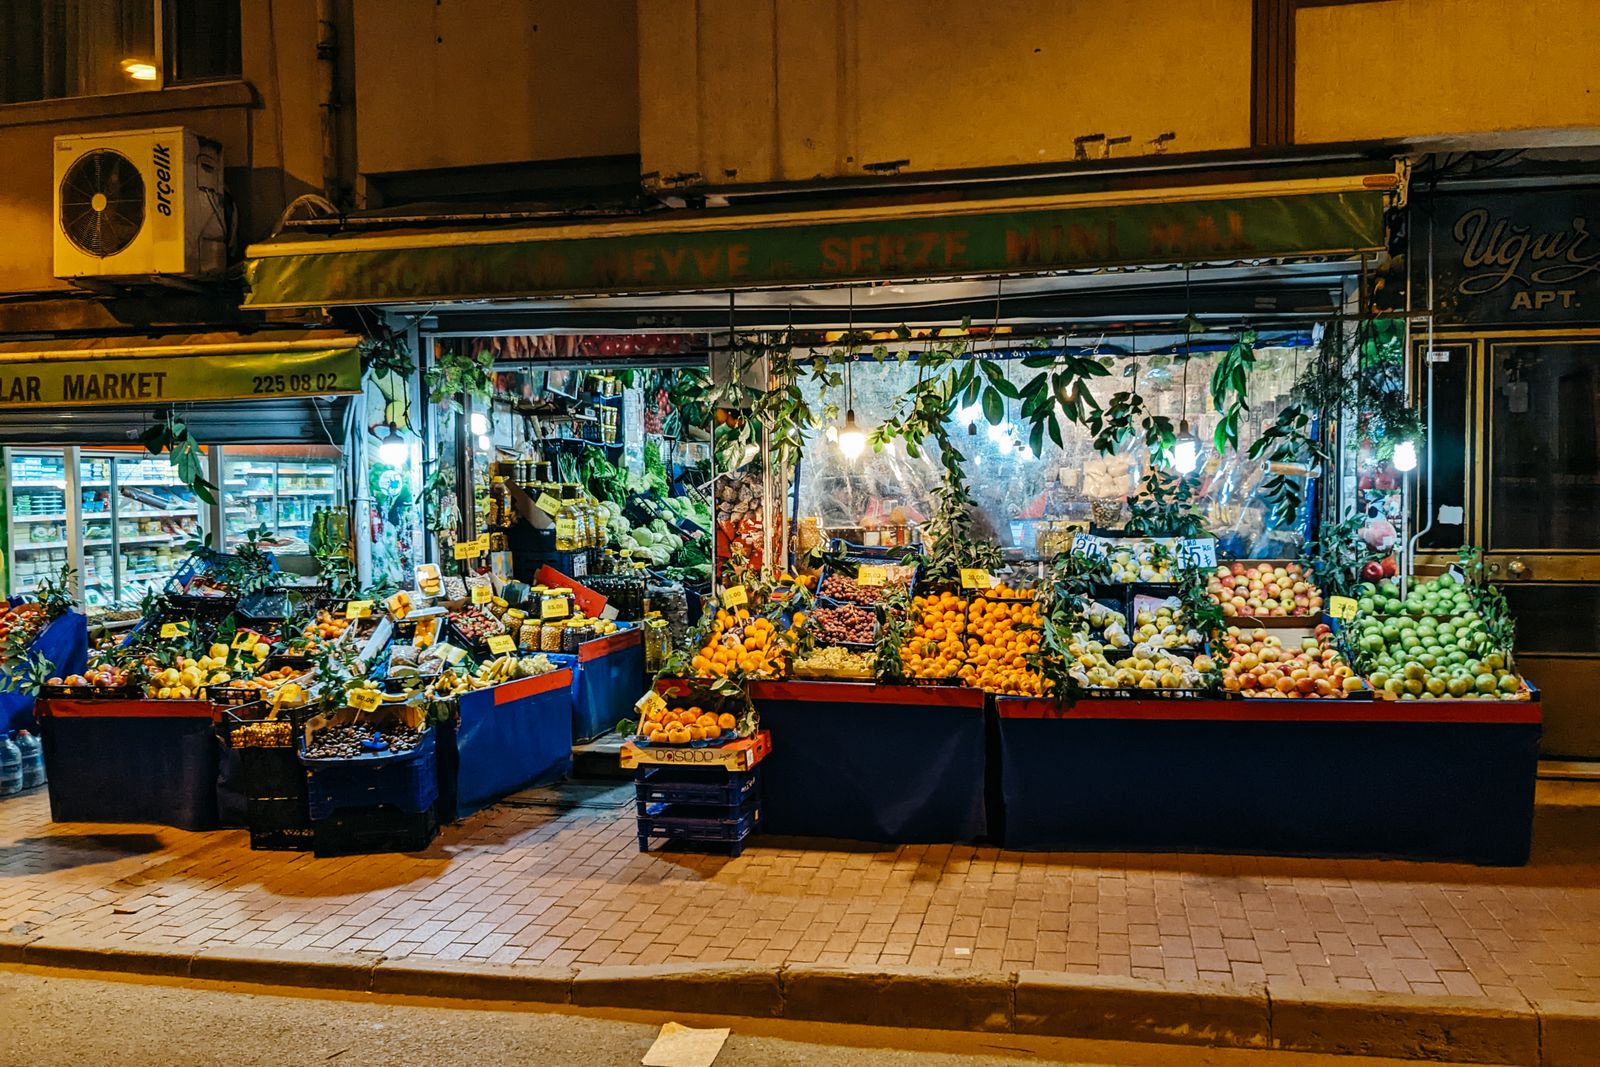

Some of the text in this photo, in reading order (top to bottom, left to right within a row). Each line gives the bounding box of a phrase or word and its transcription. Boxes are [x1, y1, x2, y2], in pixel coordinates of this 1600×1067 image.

[153, 143, 174, 216] arçelik
[819, 231, 971, 273] SEBZE
[1510, 290, 1581, 310] APT.
[64, 372, 167, 400] MARKET
[253, 375, 285, 393] 225
[290, 374, 311, 391] 08
[317, 373, 337, 391] 02
